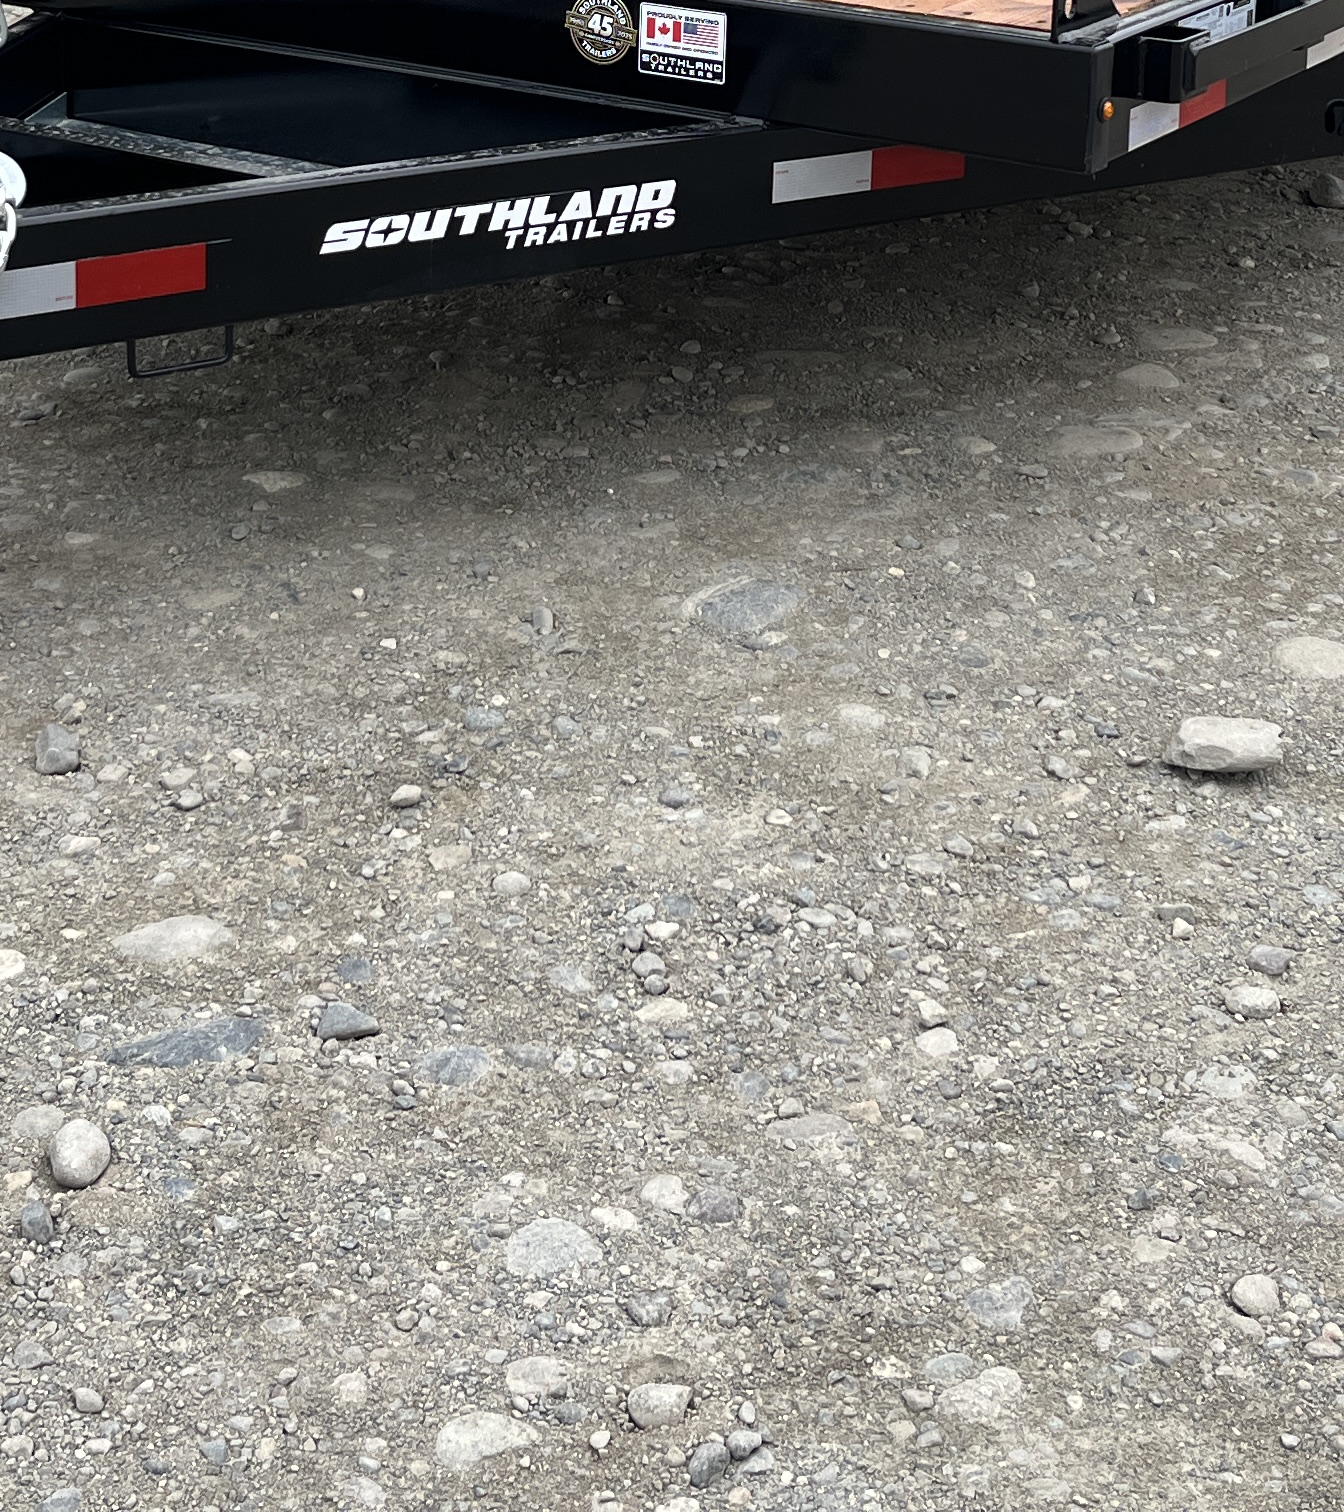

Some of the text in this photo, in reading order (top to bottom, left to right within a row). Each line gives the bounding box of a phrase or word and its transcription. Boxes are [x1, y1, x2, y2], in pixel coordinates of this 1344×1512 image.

[587, 13, 614, 37] 45
[646, 10, 720, 26] PROUDLY SERVING
[581, 39, 617, 58] TRAILERS
[641, 53, 722, 73] SOUTHLAND
[650, 62, 714, 79] TRAILERS
[318, 179, 677, 255] SOUTHLAND
[503, 208, 677, 250] TRAILERS
